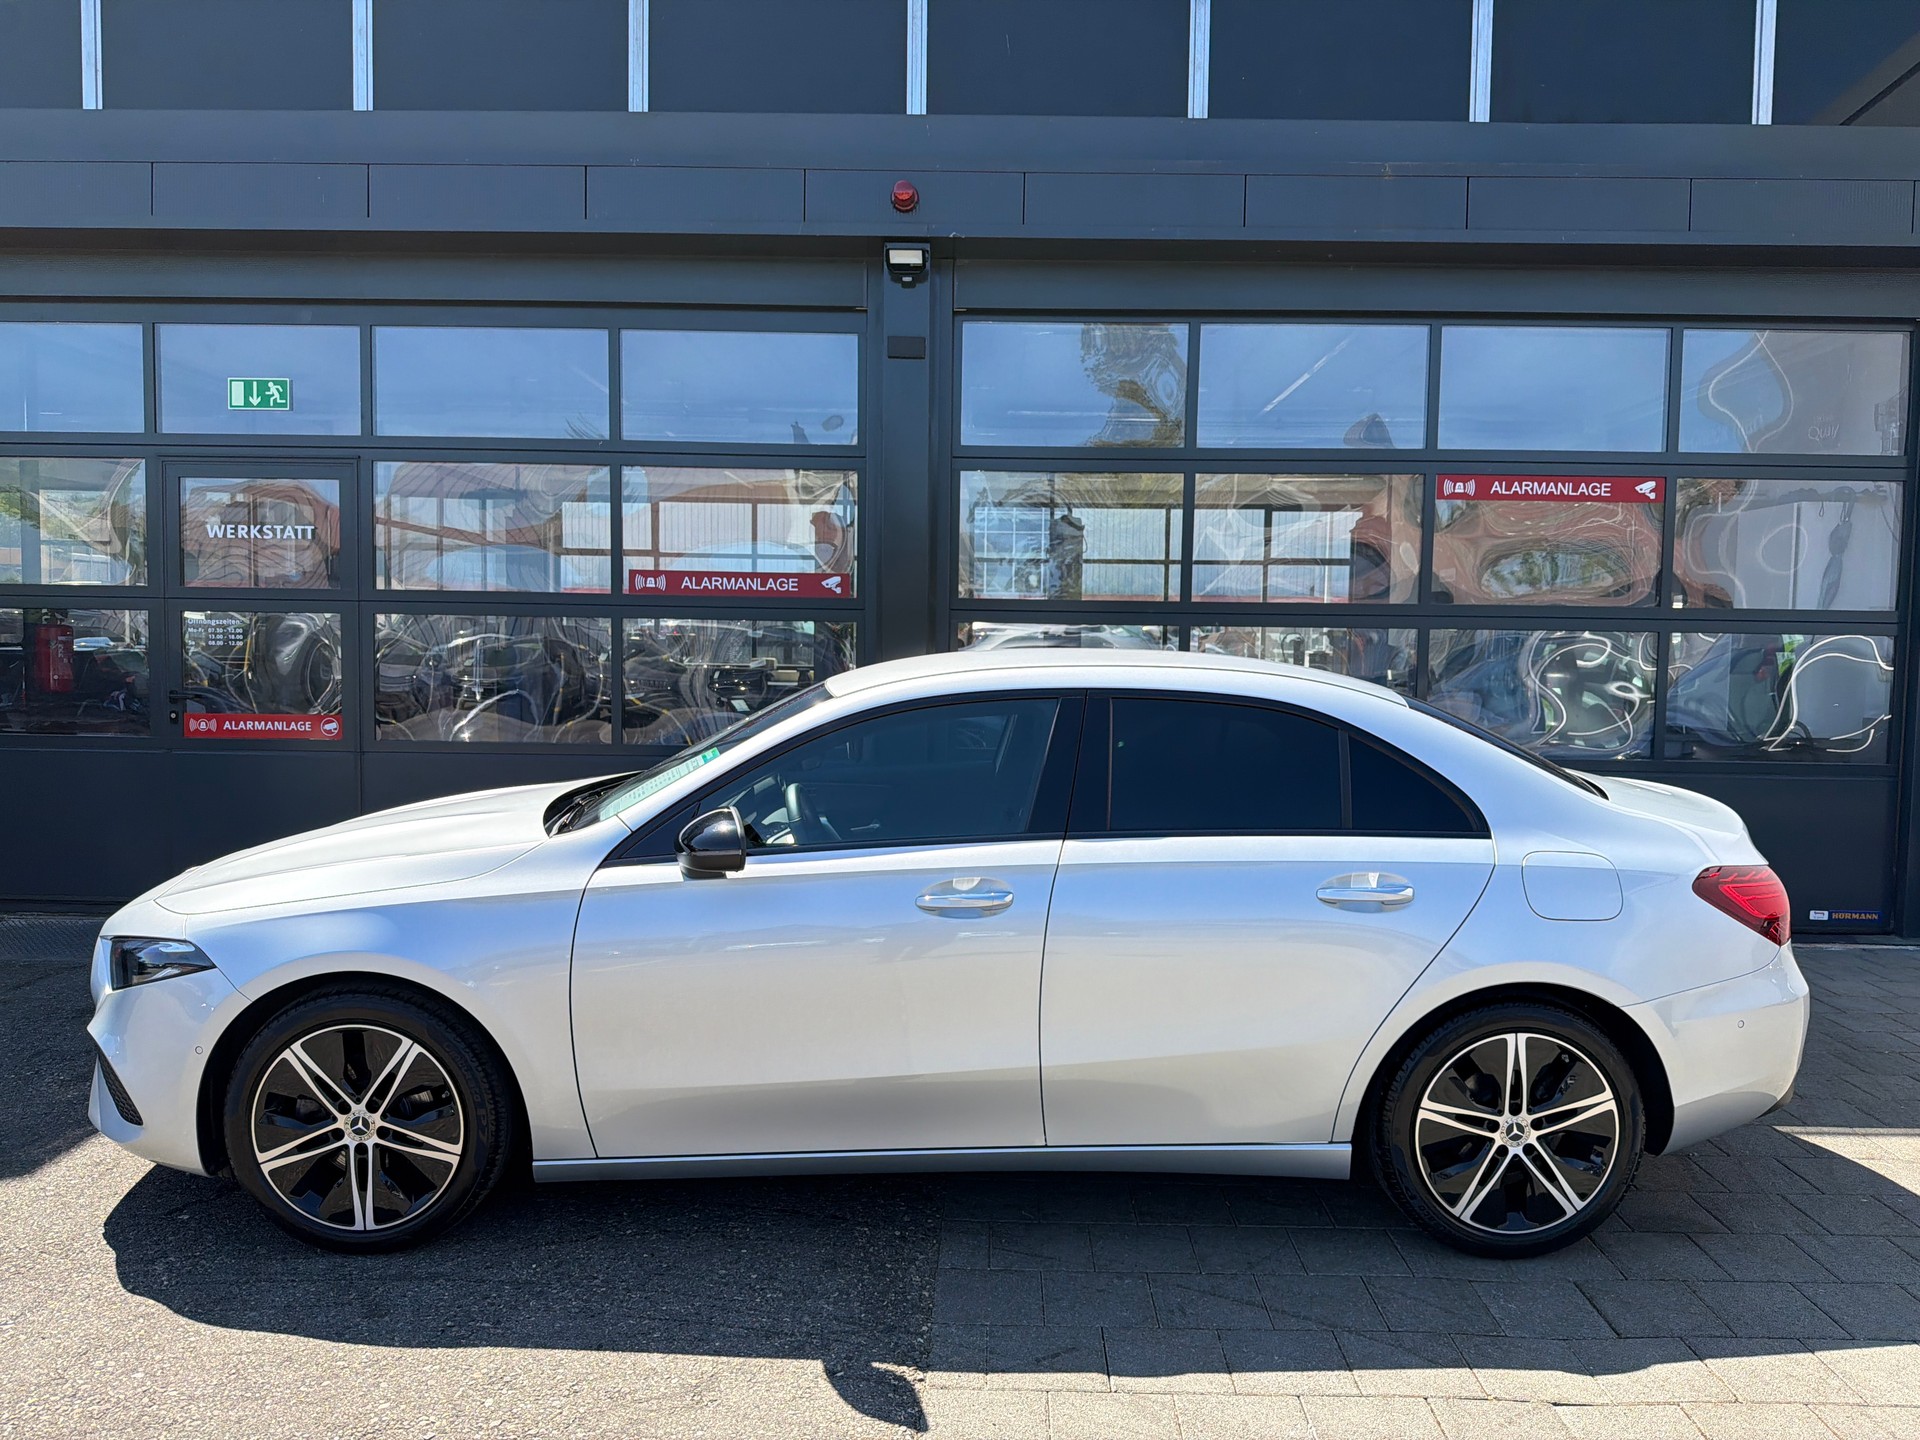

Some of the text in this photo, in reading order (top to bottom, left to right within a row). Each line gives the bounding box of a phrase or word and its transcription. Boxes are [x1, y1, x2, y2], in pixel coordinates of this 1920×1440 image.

[1490, 481, 1611, 496] ALARMANLAGE
[206, 524, 315, 540] WERKSTATT
[681, 576, 798, 592] ALARMANLAGE
[223, 720, 312, 731] ALARMANLAGE
